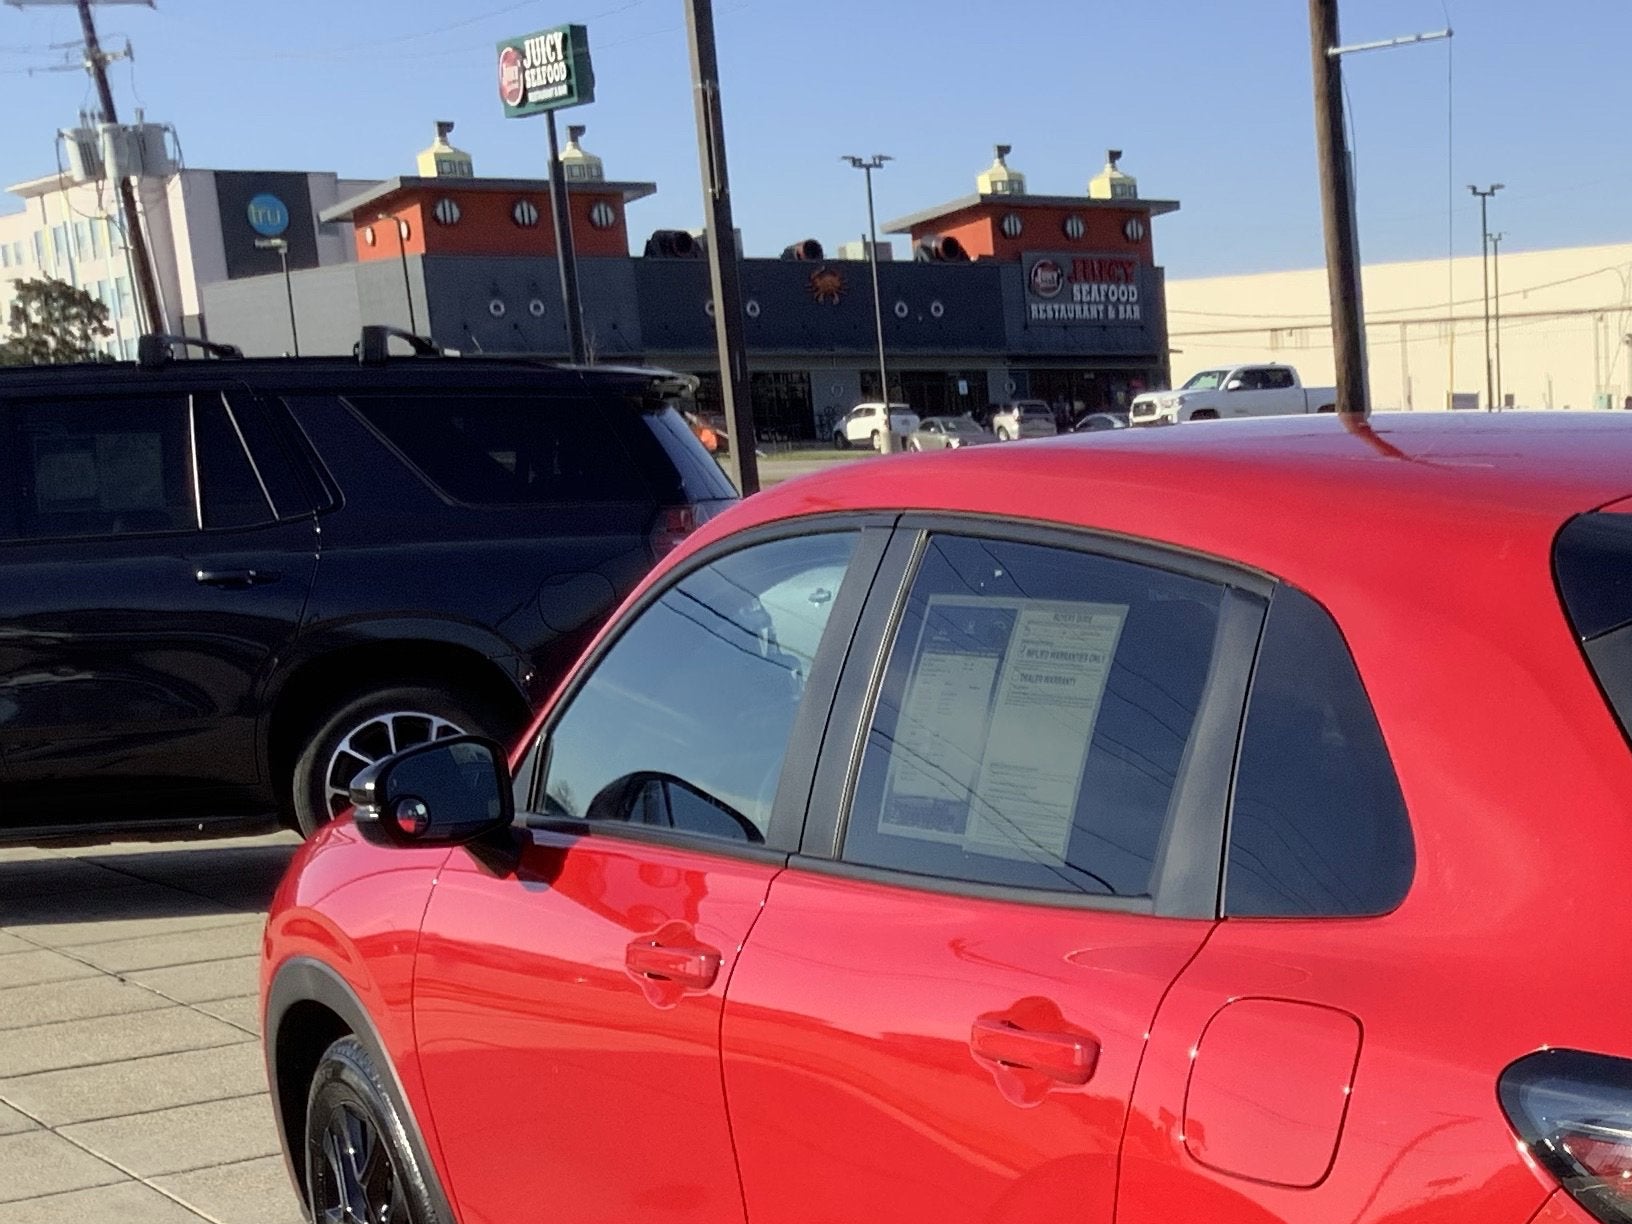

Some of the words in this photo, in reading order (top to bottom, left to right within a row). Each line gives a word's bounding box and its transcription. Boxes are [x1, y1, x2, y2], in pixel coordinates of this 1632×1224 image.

[523, 32, 563, 68] JUICY
[525, 62, 567, 88] SEAFOOD
[1067, 258, 1136, 284] JUICY
[1073, 284, 1138, 302] SEAFOOD
[1030, 303, 1104, 320] RESTAURANT
[1107, 304, 1115, 319] &
[1118, 303, 1141, 320] BAR
